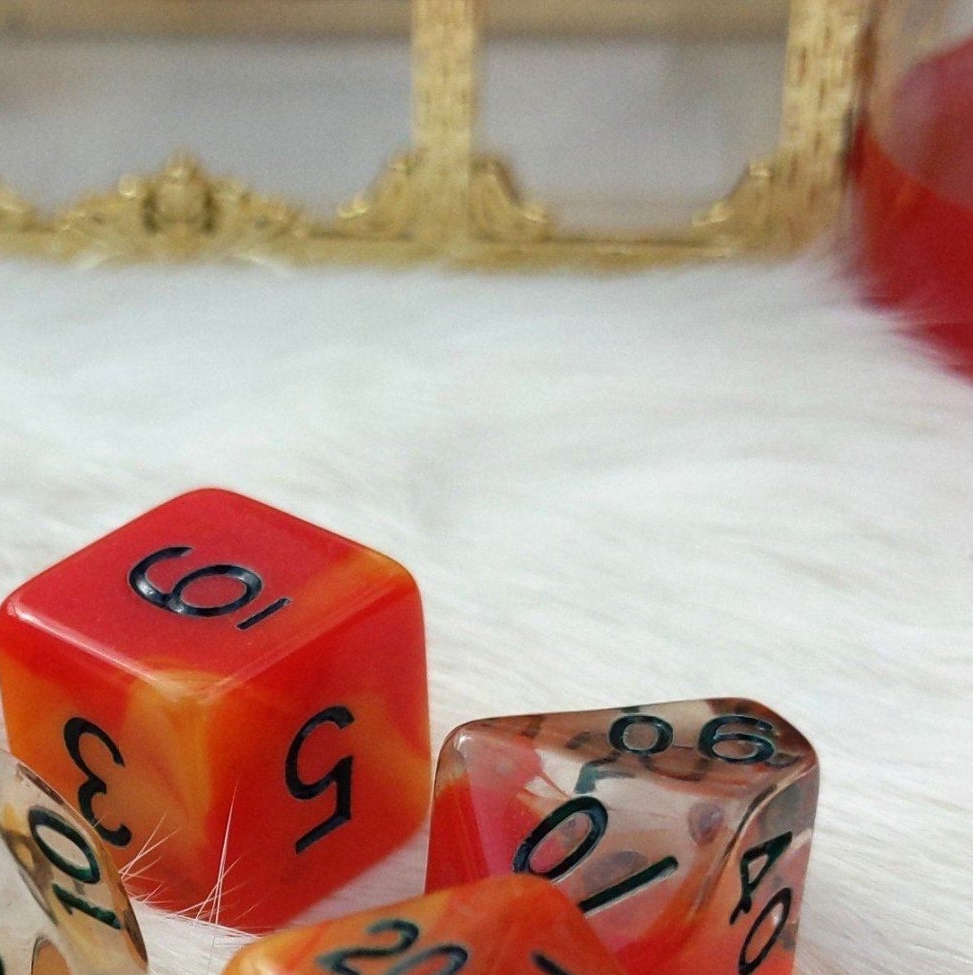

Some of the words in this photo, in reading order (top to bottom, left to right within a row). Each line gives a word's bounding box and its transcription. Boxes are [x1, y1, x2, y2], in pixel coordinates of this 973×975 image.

[129, 546, 291, 631] 6
[63, 716, 132, 848] 3
[285, 705, 355, 855] 5
[27, 805, 123, 930] 10
[513, 796, 680, 918] 10
